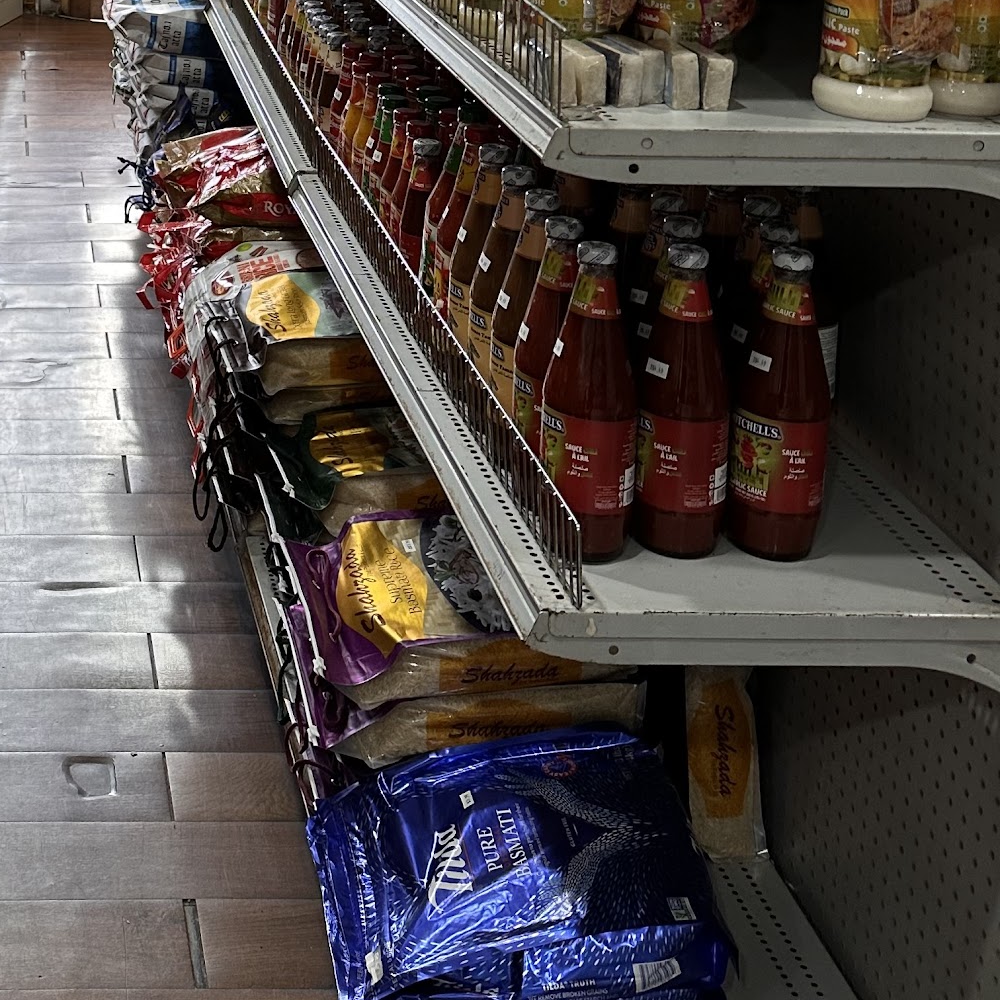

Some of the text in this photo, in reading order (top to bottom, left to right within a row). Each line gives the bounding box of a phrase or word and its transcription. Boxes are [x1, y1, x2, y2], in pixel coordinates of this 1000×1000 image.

[650, 0, 671, 10] Paste
[838, 24, 860, 36] Paste
[775, 305, 796, 319] SAUCE
[565, 442, 583, 453] SAUCE
[654, 442, 671, 453] SAUCE
[747, 485, 767, 498] SAUCE
[344, 549, 386, 633] Shahzada
[375, 559, 402, 605] Supreme
[384, 547, 422, 614] Basmati Rice
[461, 662, 560, 685] Shahzada
[714, 704, 738, 798] Shahzada
[477, 826, 503, 873] PURE
[496, 808, 533, 878] BASMATI
[427, 823, 474, 914] Tilda
[570, 979, 596, 988] TRUTH
